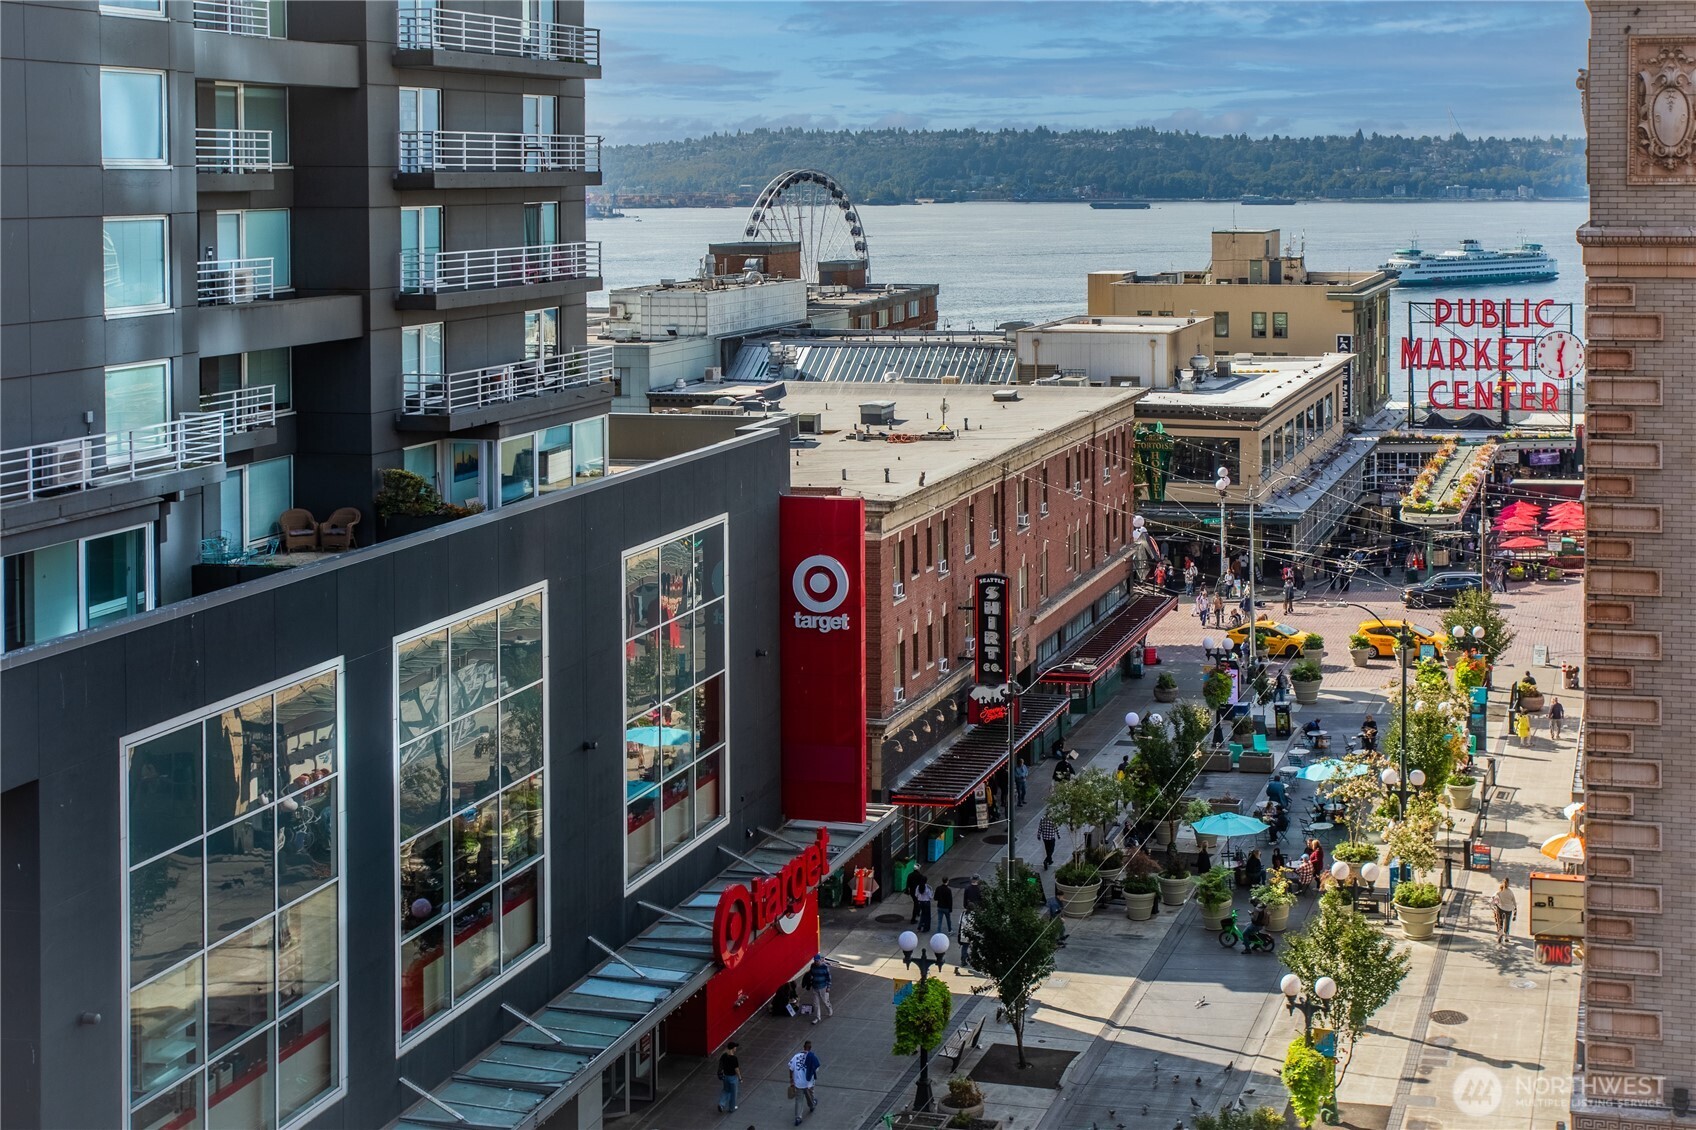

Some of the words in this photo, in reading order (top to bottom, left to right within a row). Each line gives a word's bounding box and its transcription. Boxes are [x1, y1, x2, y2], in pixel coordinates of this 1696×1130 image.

[1435, 298, 1554, 328] PUBLIC
[1401, 336, 1536, 371] MARKET
[1428, 380, 1559, 412] CENTER
[1151, 452, 1160, 499] HOSTEL
[794, 612, 850, 633] target
[984, 586, 1001, 660] SHIRT
[983, 663, 1002, 672] CO.
[751, 826, 829, 930] target
[1535, 944, 1572, 964] COINS
